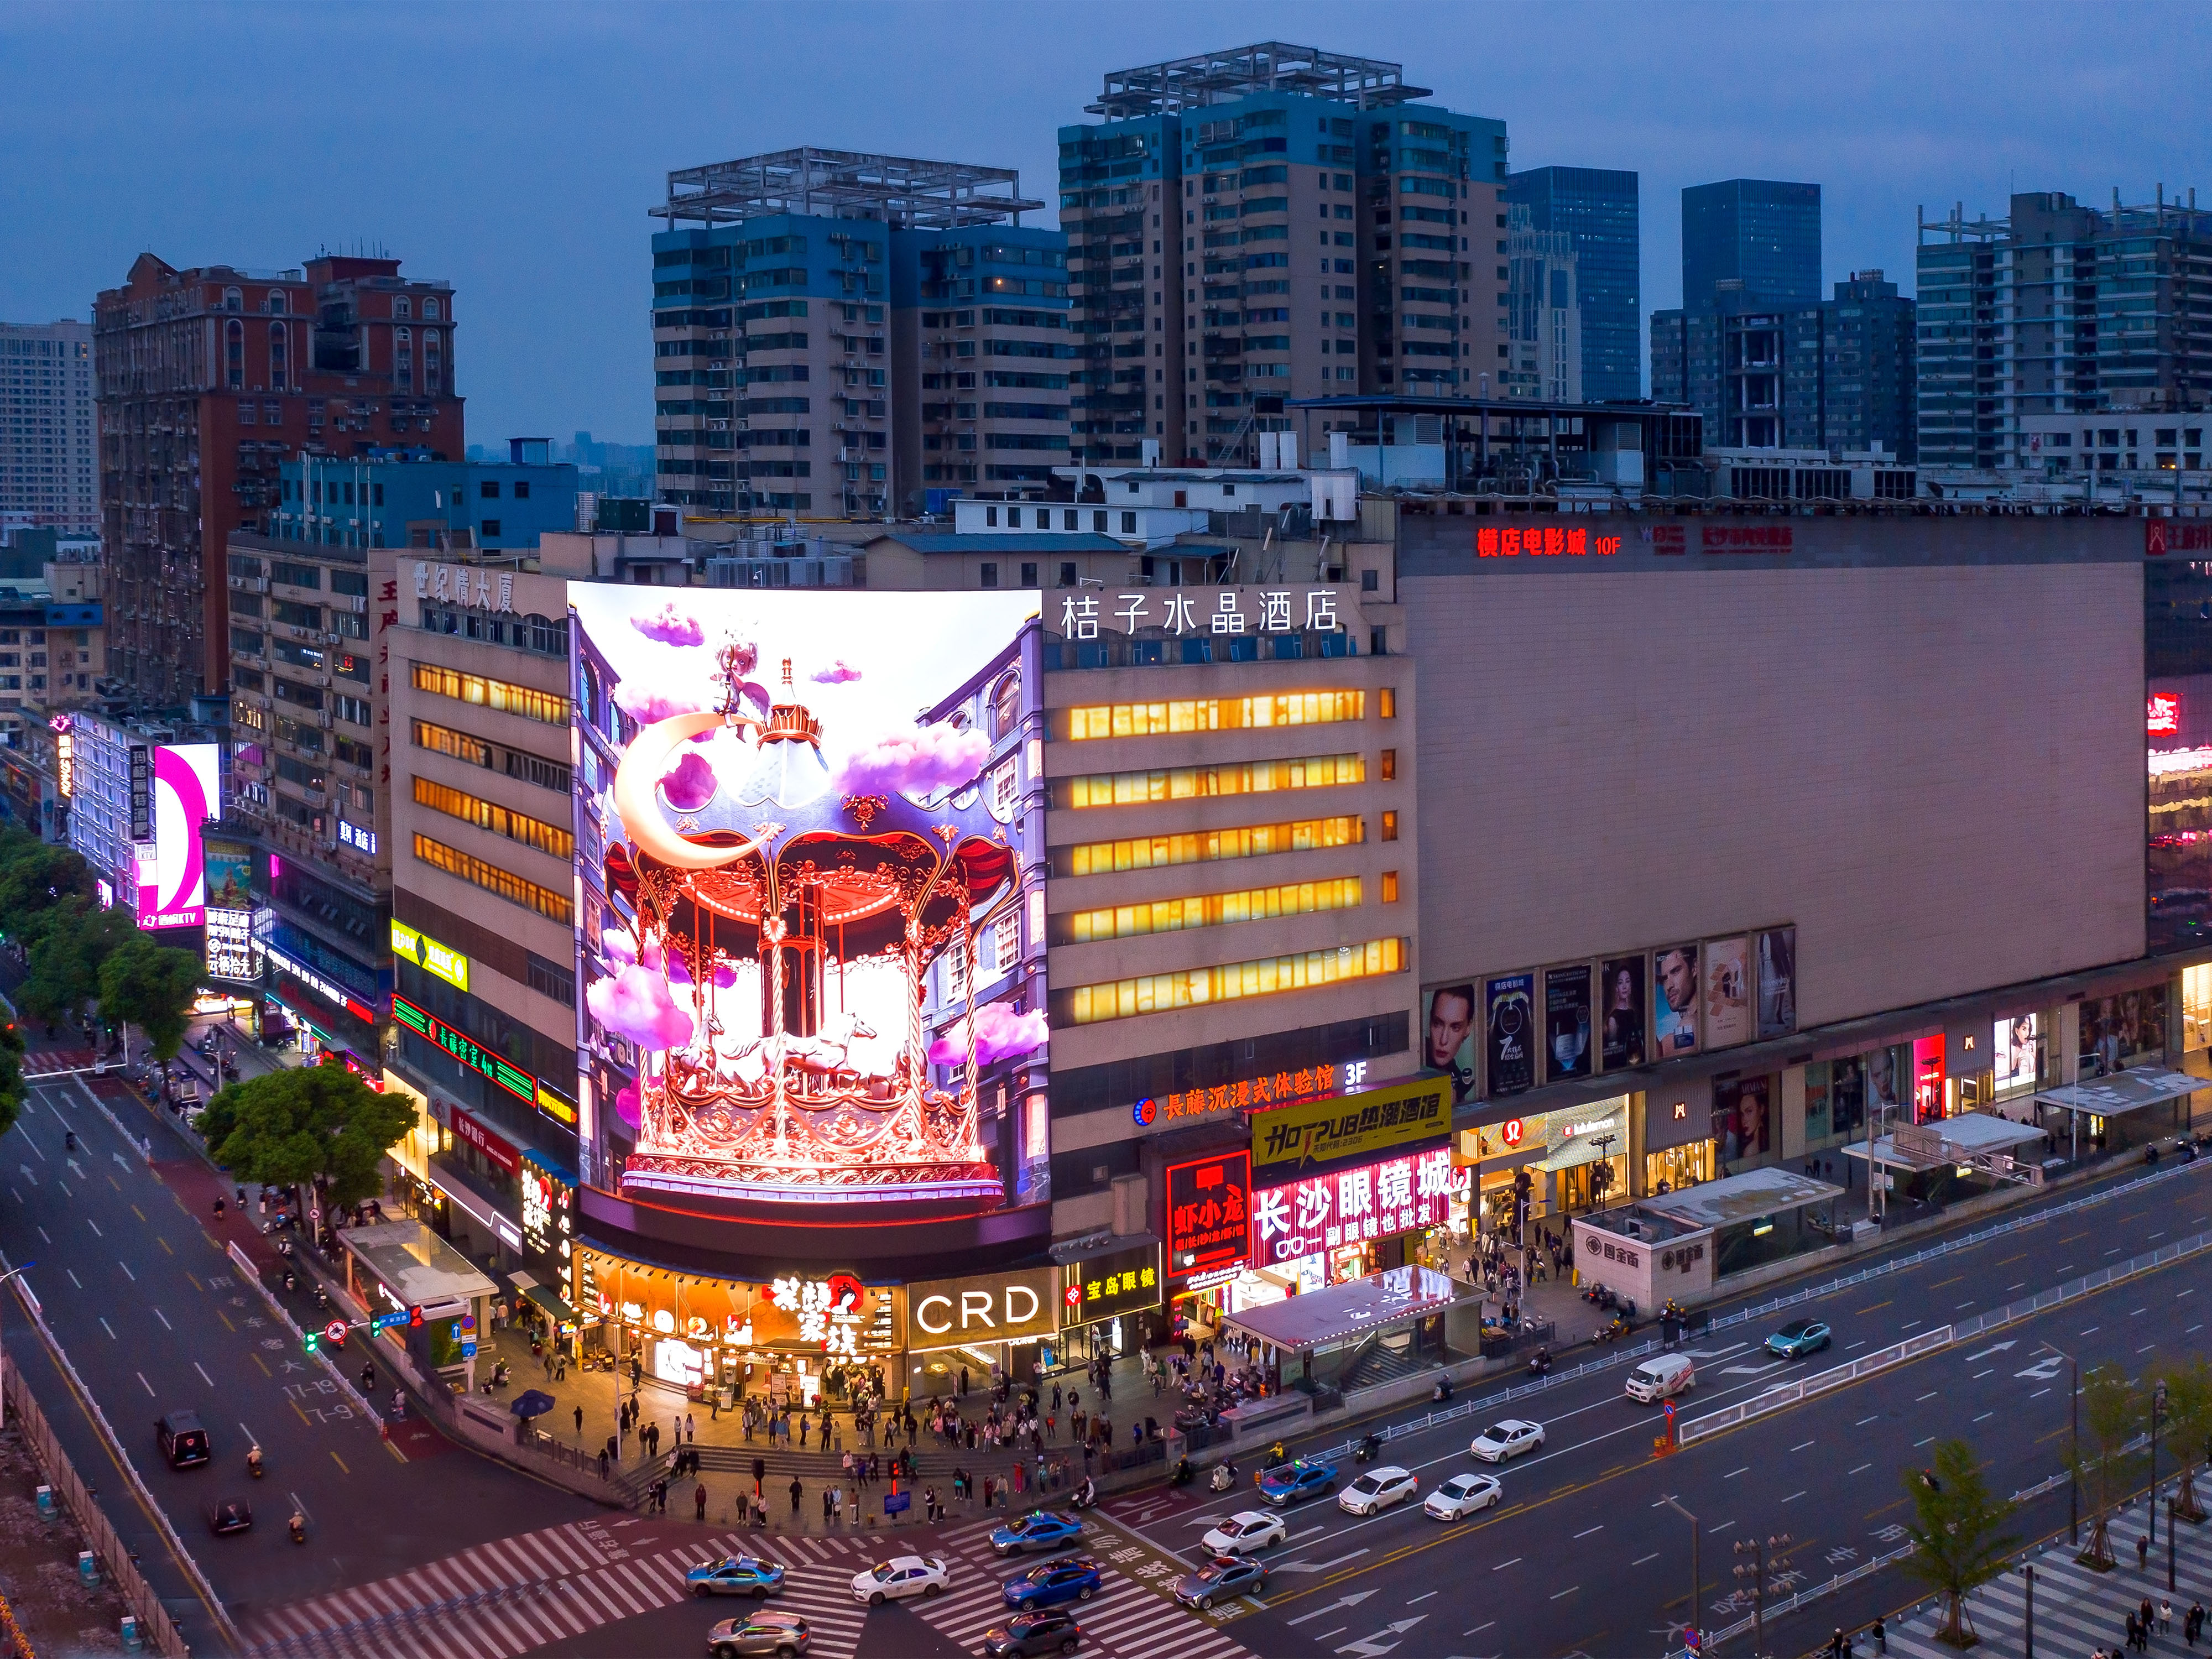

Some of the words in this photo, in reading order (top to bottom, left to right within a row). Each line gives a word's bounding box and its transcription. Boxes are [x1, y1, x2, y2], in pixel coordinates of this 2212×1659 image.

[1477, 528, 1587, 557] 横店电影城
[1594, 537, 1621, 555] 10F
[1061, 591, 1337, 639] 桔子水晶酒店
[133, 750, 148, 836] 玛格丽特酒吧
[1495, 978, 1524, 992] 横店电影城
[1163, 1065, 1335, 1120] 長藤沉浸式体验馆
[1344, 1061, 1367, 1086] 3F
[1573, 1117, 1614, 1136] lululemon
[1174, 1184, 1244, 1235] 虾小龙
[1254, 1150, 1450, 1241] 长沙眼镜城
[1307, 1203, 1432, 1249] 一副眼镜也批发
[1087, 1267, 1155, 1301] 宝岛眼镜
[917, 1286, 1039, 1334] CRD
[283, 1380, 337, 1401] 17-19
[305, 1405, 354, 1423] 7-9
